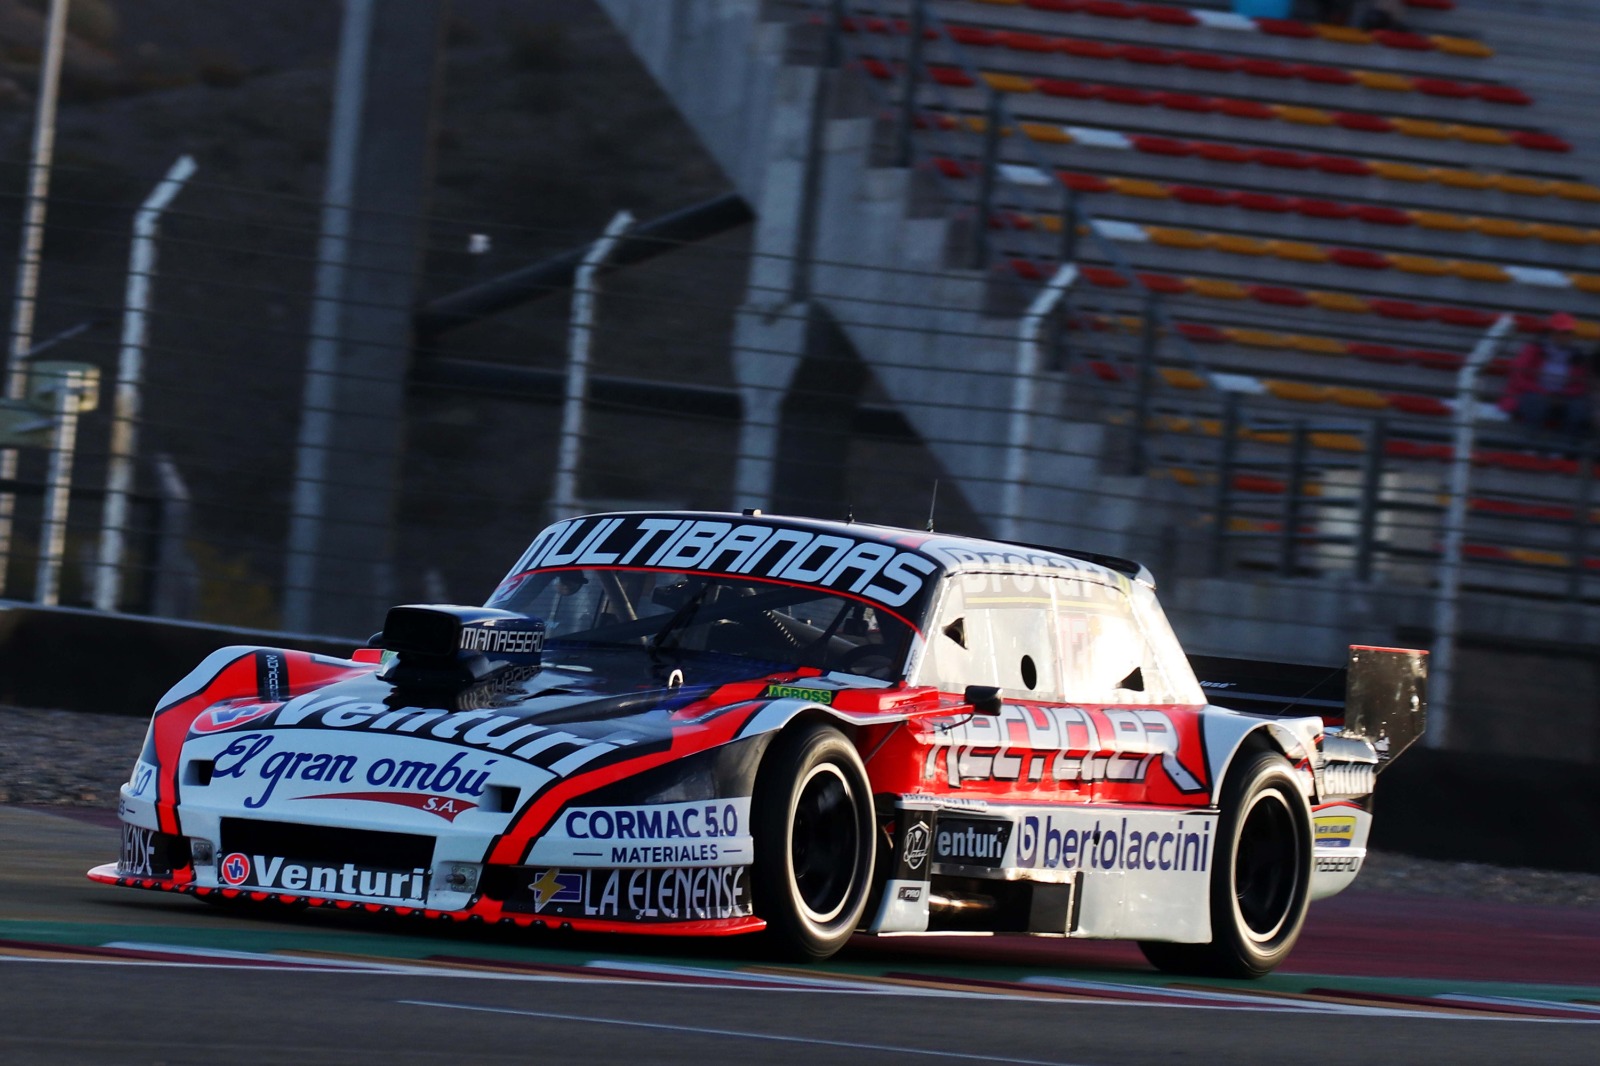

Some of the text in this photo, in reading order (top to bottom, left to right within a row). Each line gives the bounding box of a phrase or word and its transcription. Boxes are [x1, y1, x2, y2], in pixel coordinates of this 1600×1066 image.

[511, 518, 938, 608] MULTIBANDAS
[460, 627, 544, 652] MANASSERO
[770, 685, 832, 704] AGROSS
[273, 693, 639, 778] Venturi
[210, 733, 499, 808] El gran ombú
[422, 797, 458, 814] S.A.
[565, 804, 738, 839] CORMAC 5.0
[611, 843, 719, 863] MATERIALES
[1045, 815, 1210, 872] bertolaccini
[252, 855, 425, 900] Venturi
[584, 866, 745, 919] LA ELENENSE
